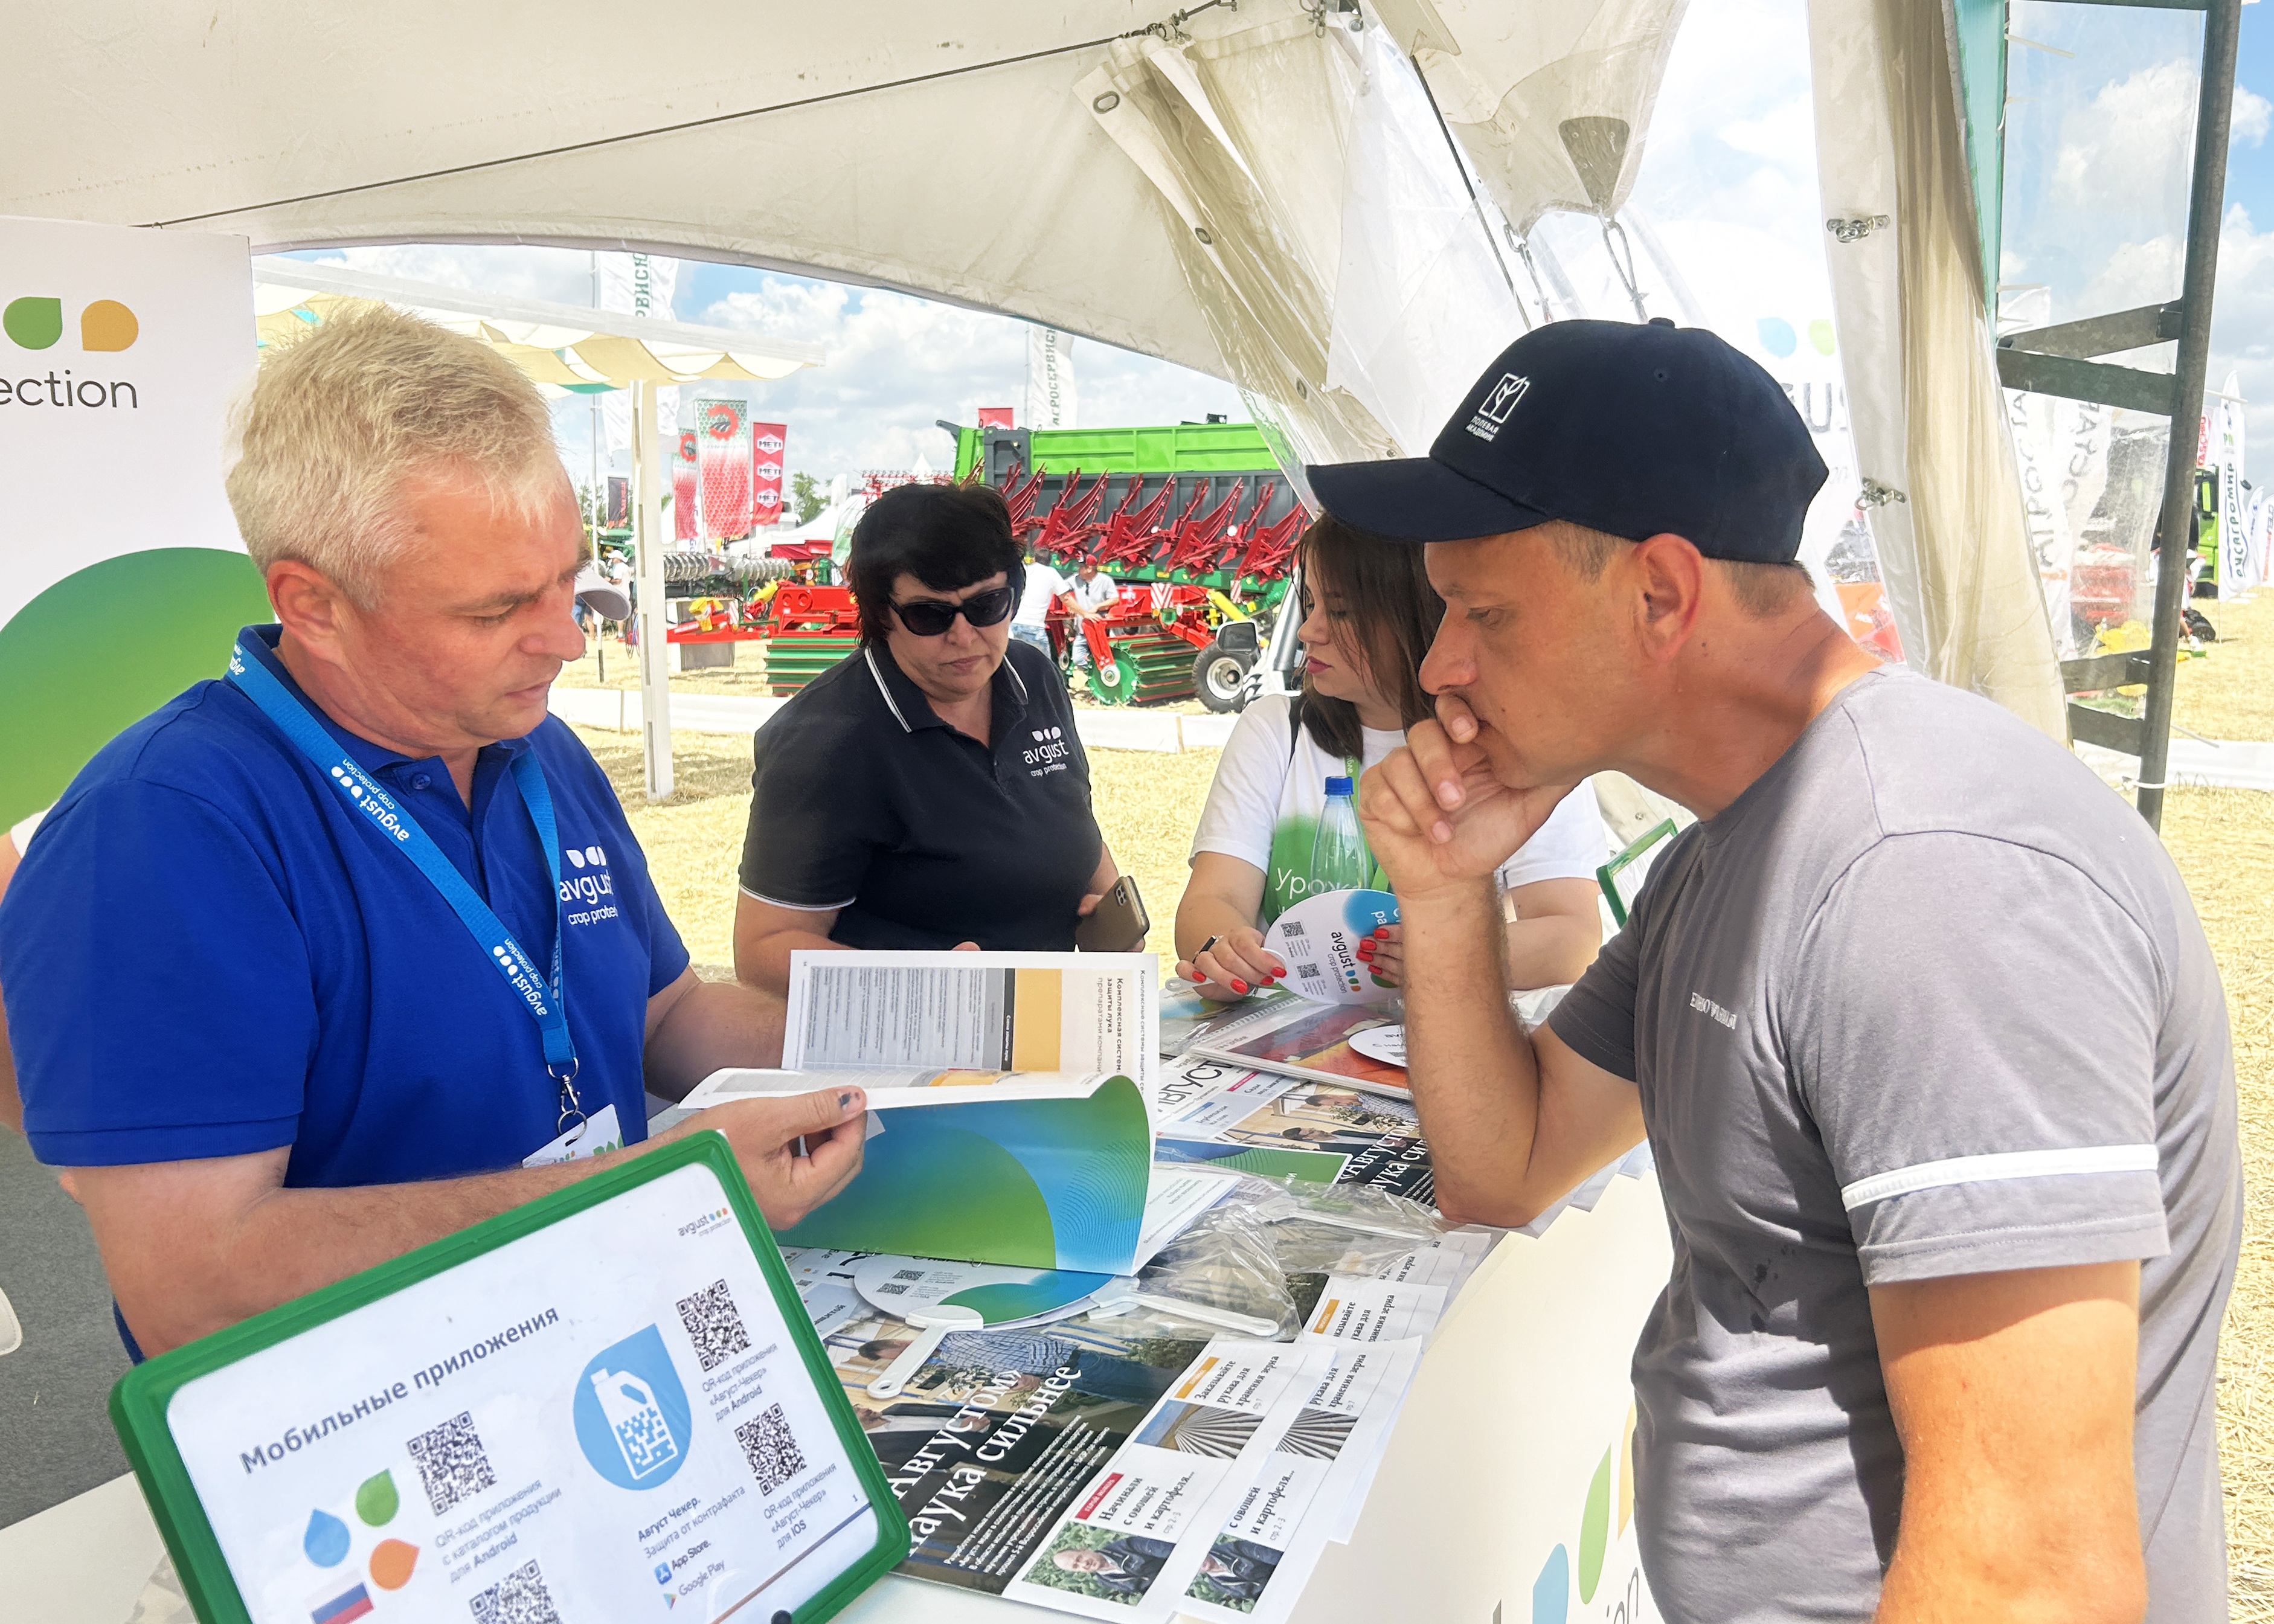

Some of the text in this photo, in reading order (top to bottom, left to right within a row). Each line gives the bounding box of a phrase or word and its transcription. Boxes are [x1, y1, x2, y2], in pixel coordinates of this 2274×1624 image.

[1023, 739, 1069, 764] avgust
[342, 759, 395, 809] crop protection
[359, 795, 410, 841] avgust
[568, 911, 591, 926] crop
[504, 938, 542, 989] crop protection
[1331, 931, 1356, 969] avgust
[1328, 953, 1347, 993] crop protection
[512, 973, 548, 1016] avgust
[678, 1213, 710, 1236] avgust
[1362, 1309, 1371, 1323] для
[1383, 1294, 1395, 1316] зерна
[702, 1343, 778, 1392] QR-код приложения
[1194, 1359, 1236, 1400] Заказывайте
[1216, 1367, 1251, 1404] рукава для
[1236, 1355, 1279, 1407] хранения зерна
[1309, 1367, 1340, 1407] рукава для
[1328, 1353, 1367, 1408] хранения зерна
[239, 1308, 560, 1474] Мобильные приложения
[731, 1384, 762, 1411] Android
[976, 1366, 1082, 1463] сильнее
[887, 1369, 1024, 1501] Августом»
[763, 1463, 837, 1519] QR-код приложения
[771, 1489, 826, 1533] «Август-Чекер»
[1099, 1477, 1143, 1521] Начинали
[1128, 1485, 1159, 1519] овощей
[1235, 1486, 1261, 1522] овощей
[435, 1480, 542, 1548] QR-код приложения
[638, 1516, 669, 1542] Август
[643, 1486, 746, 1559] Защита от контрафакта
[1250, 1526, 1260, 1535] и
[474, 1531, 518, 1568] Android
[777, 1532, 792, 1550] для
[671, 1554, 689, 1571] App
[679, 1559, 725, 1596] Google Play
